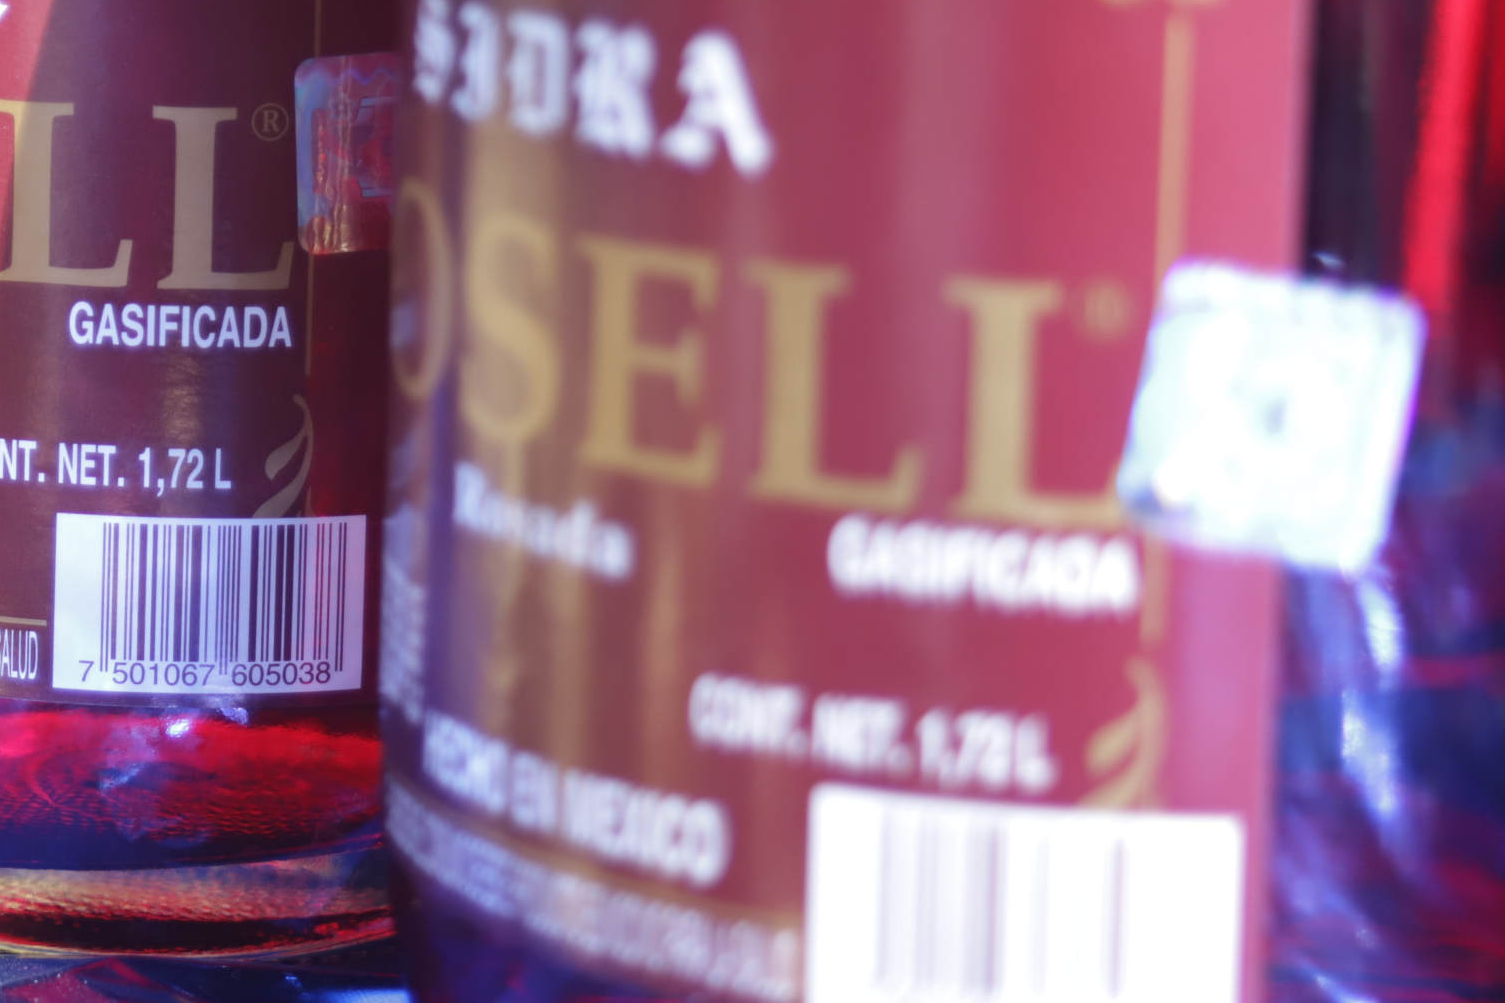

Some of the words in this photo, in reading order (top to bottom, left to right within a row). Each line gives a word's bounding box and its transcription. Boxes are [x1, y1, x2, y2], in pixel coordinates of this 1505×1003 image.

[67, 300, 293, 349] GASIFICADA
[58, 444, 125, 488] NET.
[138, 447, 204, 497] 1,72
[214, 449, 233, 489] L
[111, 662, 215, 685] 501067
[231, 661, 332, 686] 605038
